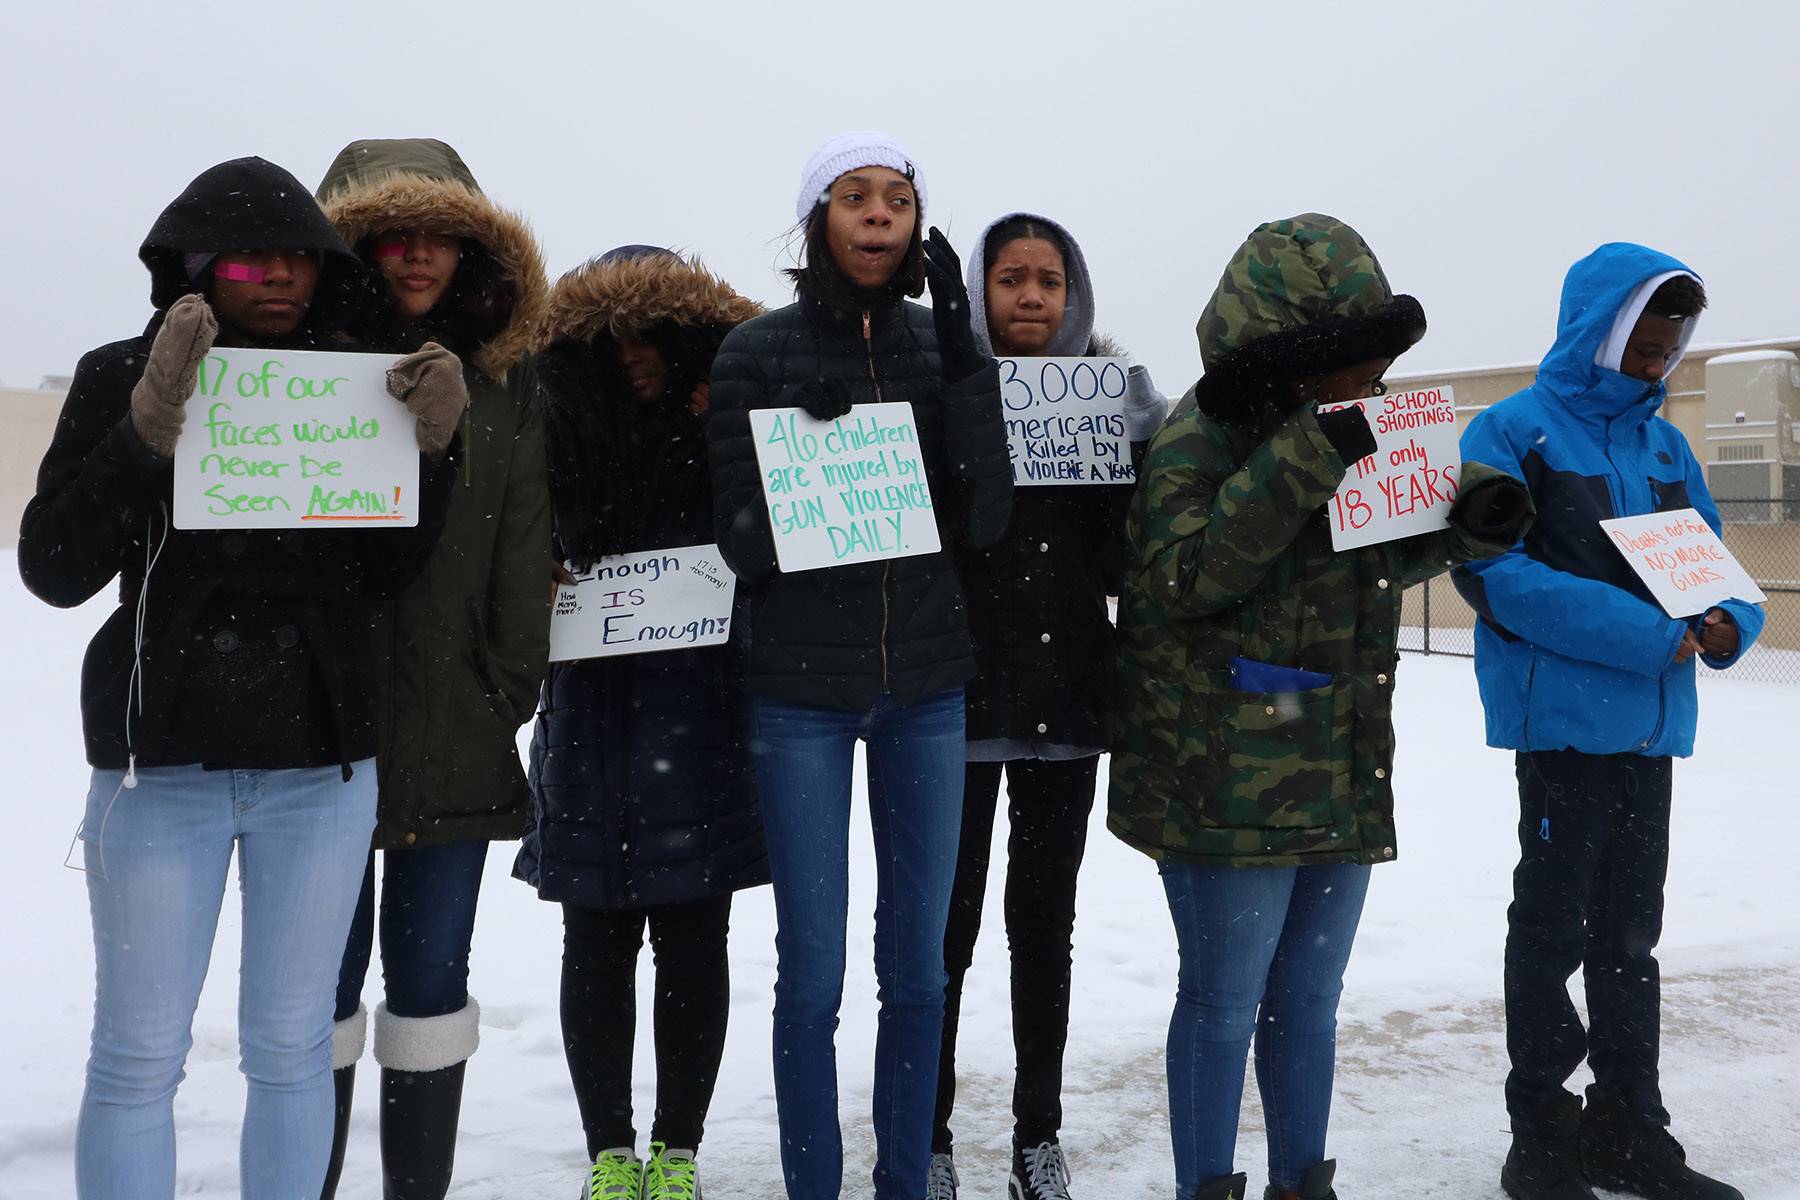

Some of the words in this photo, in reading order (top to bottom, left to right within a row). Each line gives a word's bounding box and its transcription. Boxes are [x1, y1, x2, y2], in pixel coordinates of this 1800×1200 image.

[198, 356, 228, 396] 17
[237, 360, 285, 399] of
[286, 376, 349, 400] our
[1384, 389, 1449, 414] SCHOOL
[203, 402, 282, 449] faces
[293, 415, 380, 443] would
[1005, 412, 1125, 439] mericans
[1377, 406, 1454, 434] SHOOTINGS
[767, 413, 818, 462] 46
[825, 416, 915, 454] children
[1092, 436, 1119, 462] by
[200, 454, 290, 478] never
[300, 455, 343, 479] be
[1389, 438, 1428, 471] only
[768, 466, 810, 494] are
[822, 450, 890, 489] injured
[892, 450, 919, 485] by
[1091, 464, 1105, 481] A
[1104, 461, 1136, 481] YEAR
[771, 496, 826, 535] GUN
[840, 483, 932, 517] VIOLENCE
[1333, 489, 1372, 531] 18
[1377, 466, 1458, 519] YEARS
[827, 512, 909, 559] DAILY.
[696, 560, 709, 569] 17
[1644, 552, 1677, 570] NO
[1674, 544, 1724, 566] MORE
[690, 567, 704, 576] too
[600, 588, 645, 609] IS
[602, 614, 730, 645] Enough!
